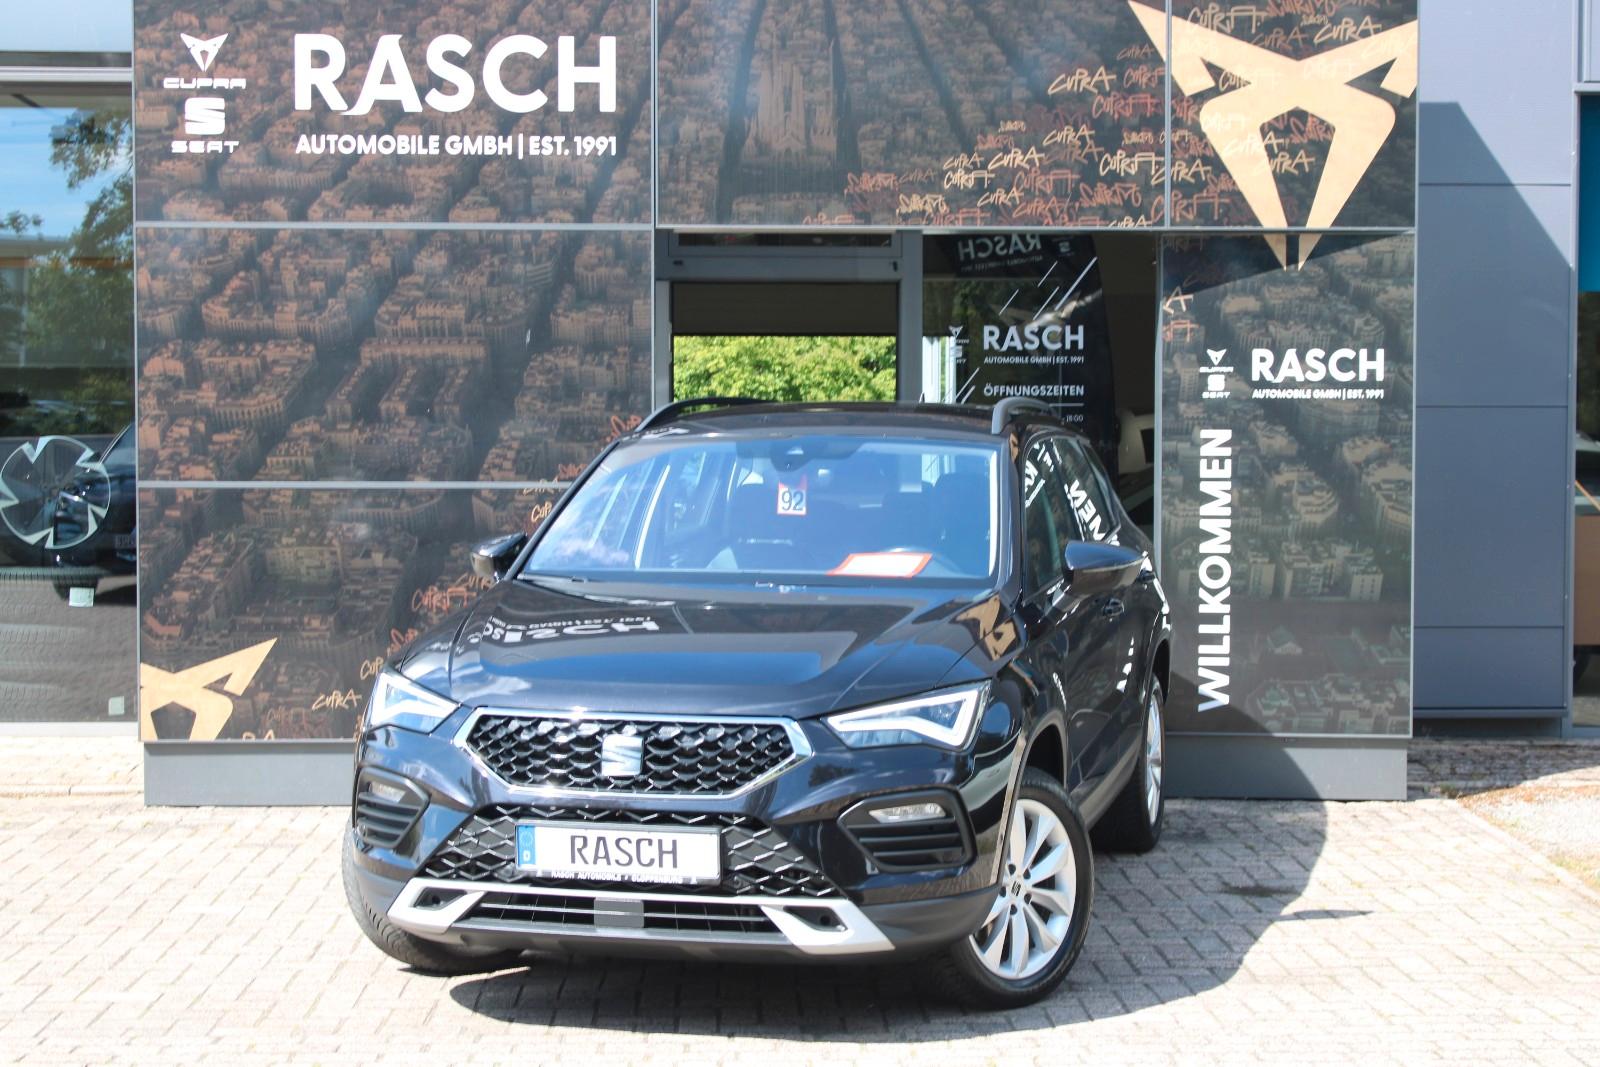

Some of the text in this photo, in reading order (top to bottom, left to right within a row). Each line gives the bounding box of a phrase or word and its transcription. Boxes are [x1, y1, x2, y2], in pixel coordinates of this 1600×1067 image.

[163, 77, 247, 89] CUPRA
[294, 33, 617, 115] RASCH
[1048, 65, 1117, 96] CUPRA
[171, 140, 239, 153] SEAT
[295, 134, 440, 156] AUTOMOBILE
[445, 135, 512, 156] GMBH
[529, 135, 570, 156] EST.
[574, 135, 617, 157] 1991
[983, 325, 1084, 352] RASCH
[984, 356, 1029, 364] AUTOMOBILE
[1030, 356, 1052, 364] GMBH
[1251, 348, 1385, 383] RASCH
[983, 383, 1084, 397] ÖFFNUNGSZEITEN
[1252, 389, 1311, 399] AUTOMOBILE
[1312, 389, 1341, 399] GMBH
[1347, 389, 1364, 399] EST.
[1365, 389, 1385, 399] 1991
[781, 489, 805, 512] 92
[1197, 428, 1233, 713] WILLKOMMEN
[569, 834, 679, 869] RASCH
